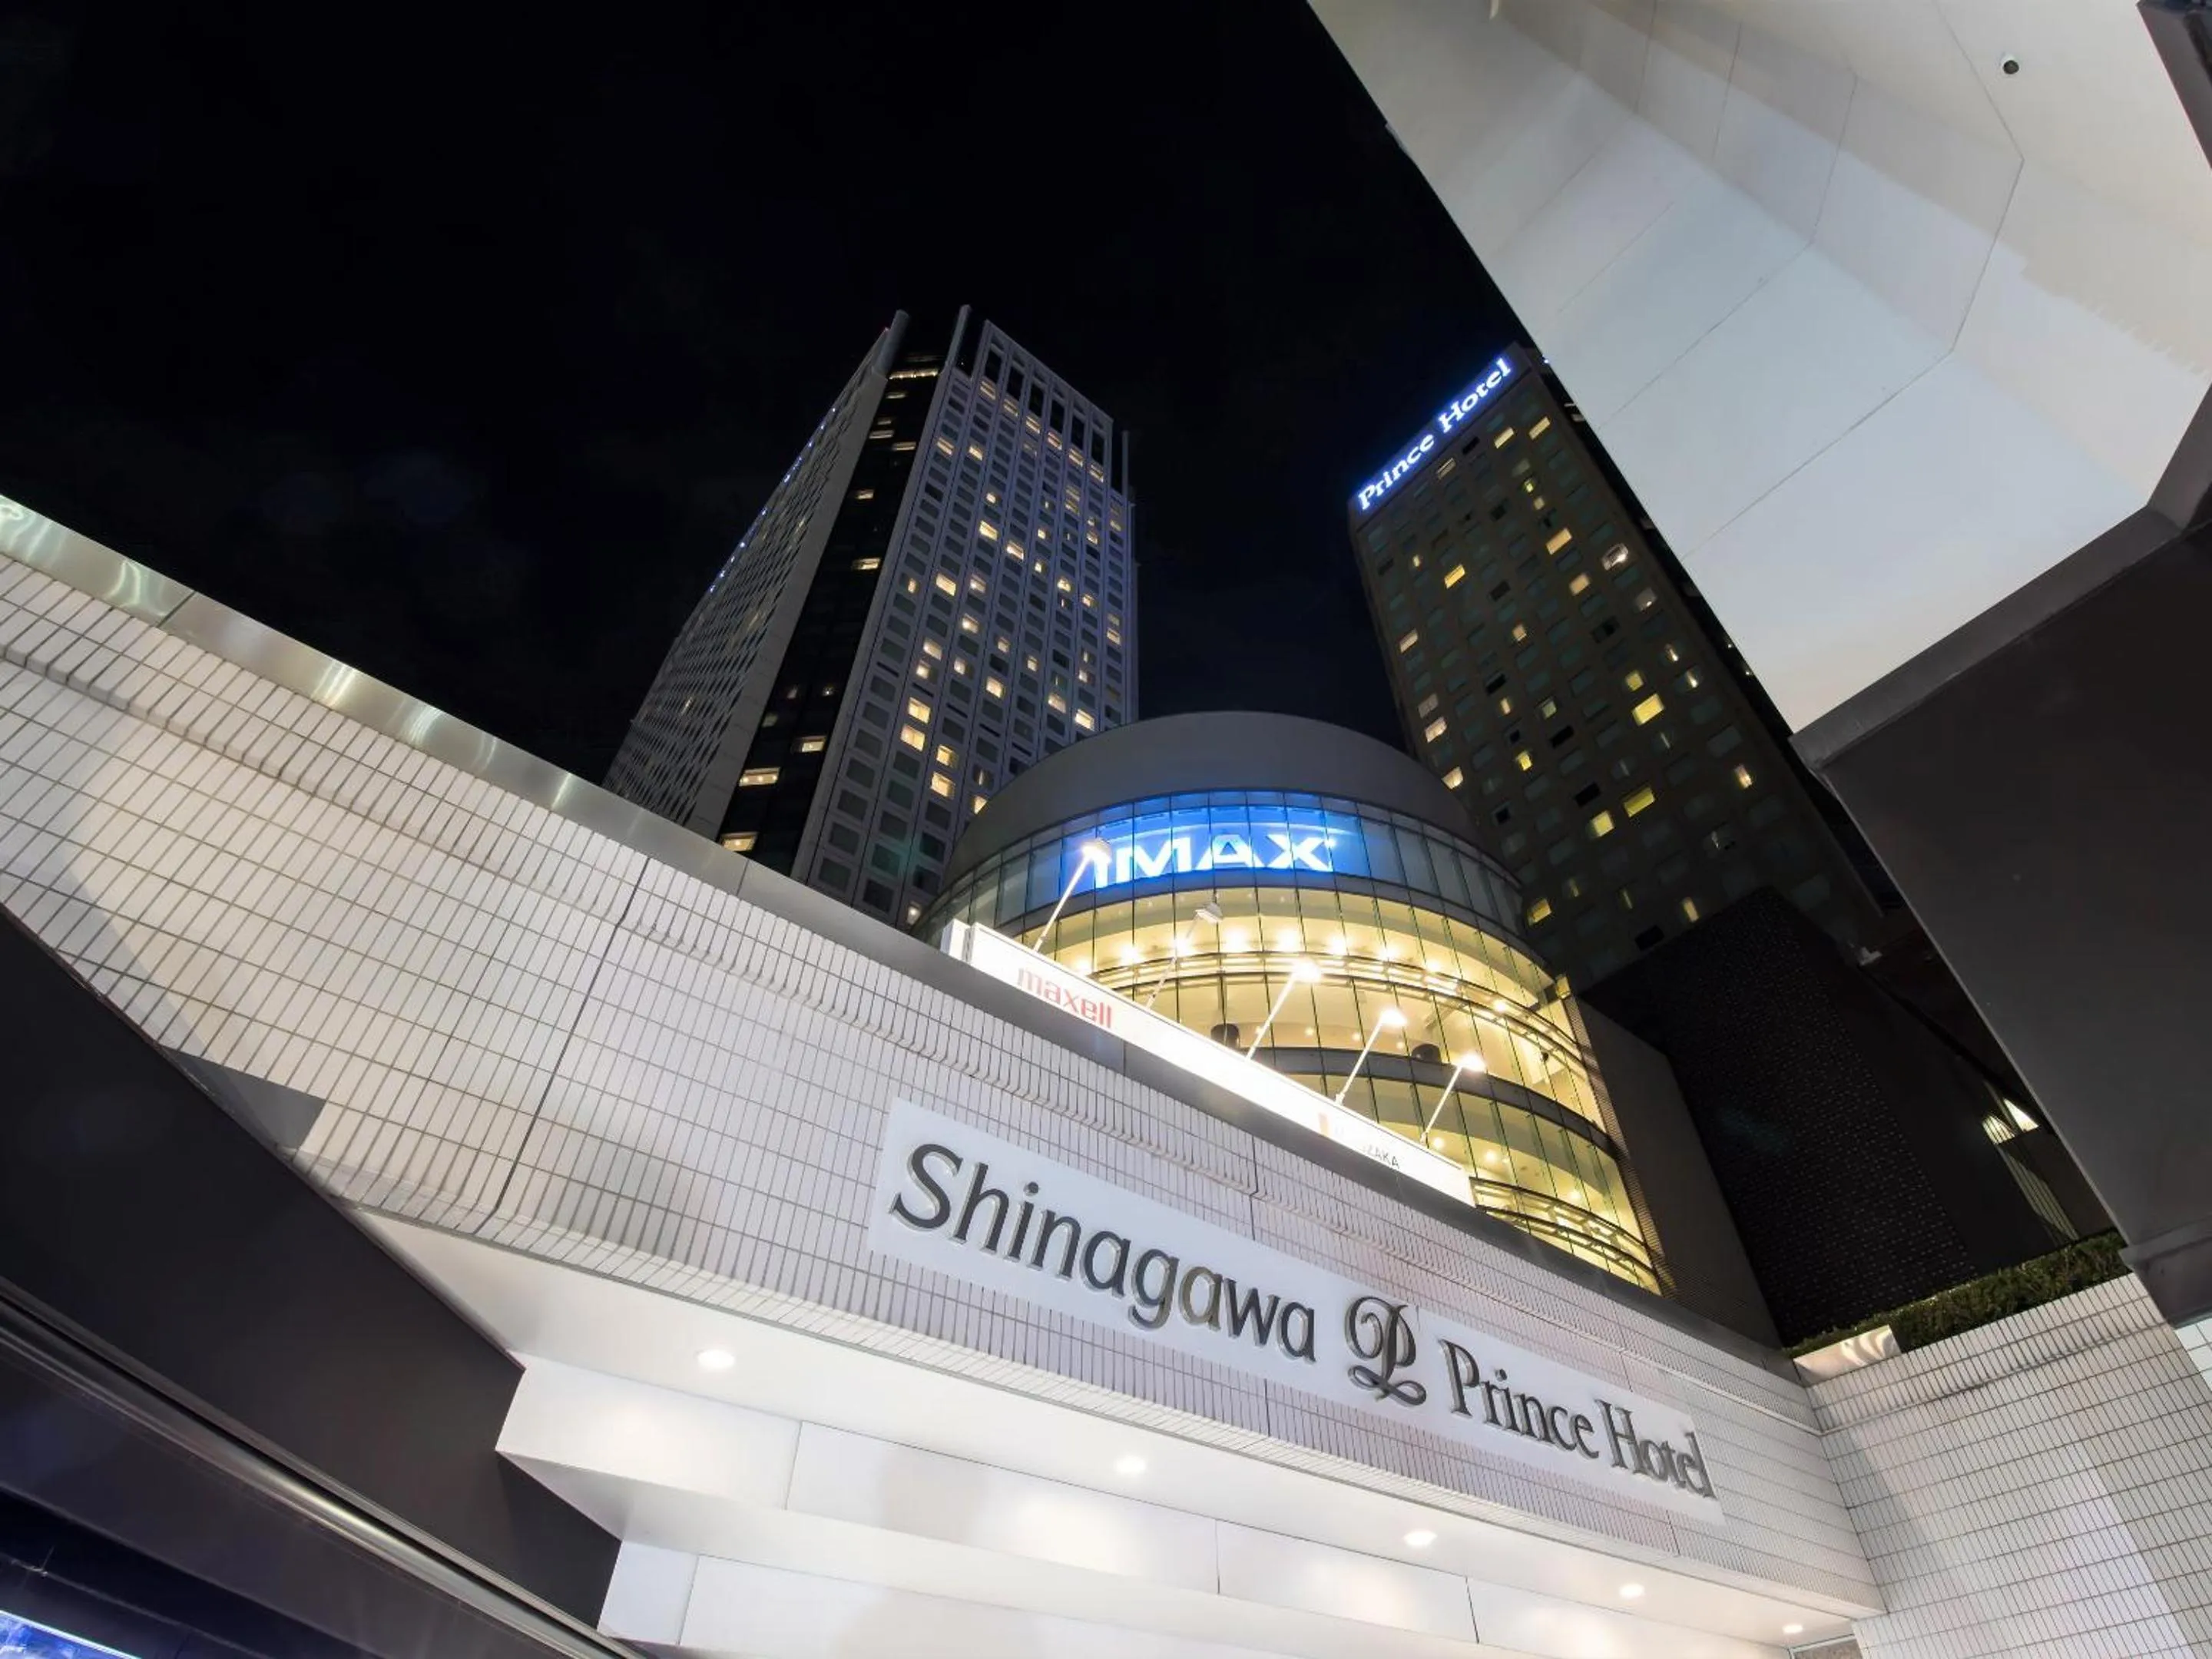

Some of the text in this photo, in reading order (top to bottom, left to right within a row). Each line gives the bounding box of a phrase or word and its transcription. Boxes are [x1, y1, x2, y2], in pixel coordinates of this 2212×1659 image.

[1358, 358, 1511, 511] Prince Hotel
[1088, 834, 1334, 888] IMAX
[1018, 967, 1111, 1028] maxell
[887, 1144, 1316, 1363] Shinagawa
[1438, 1339, 1600, 1459] Prince
[1596, 1398, 1717, 1500] Hotel
